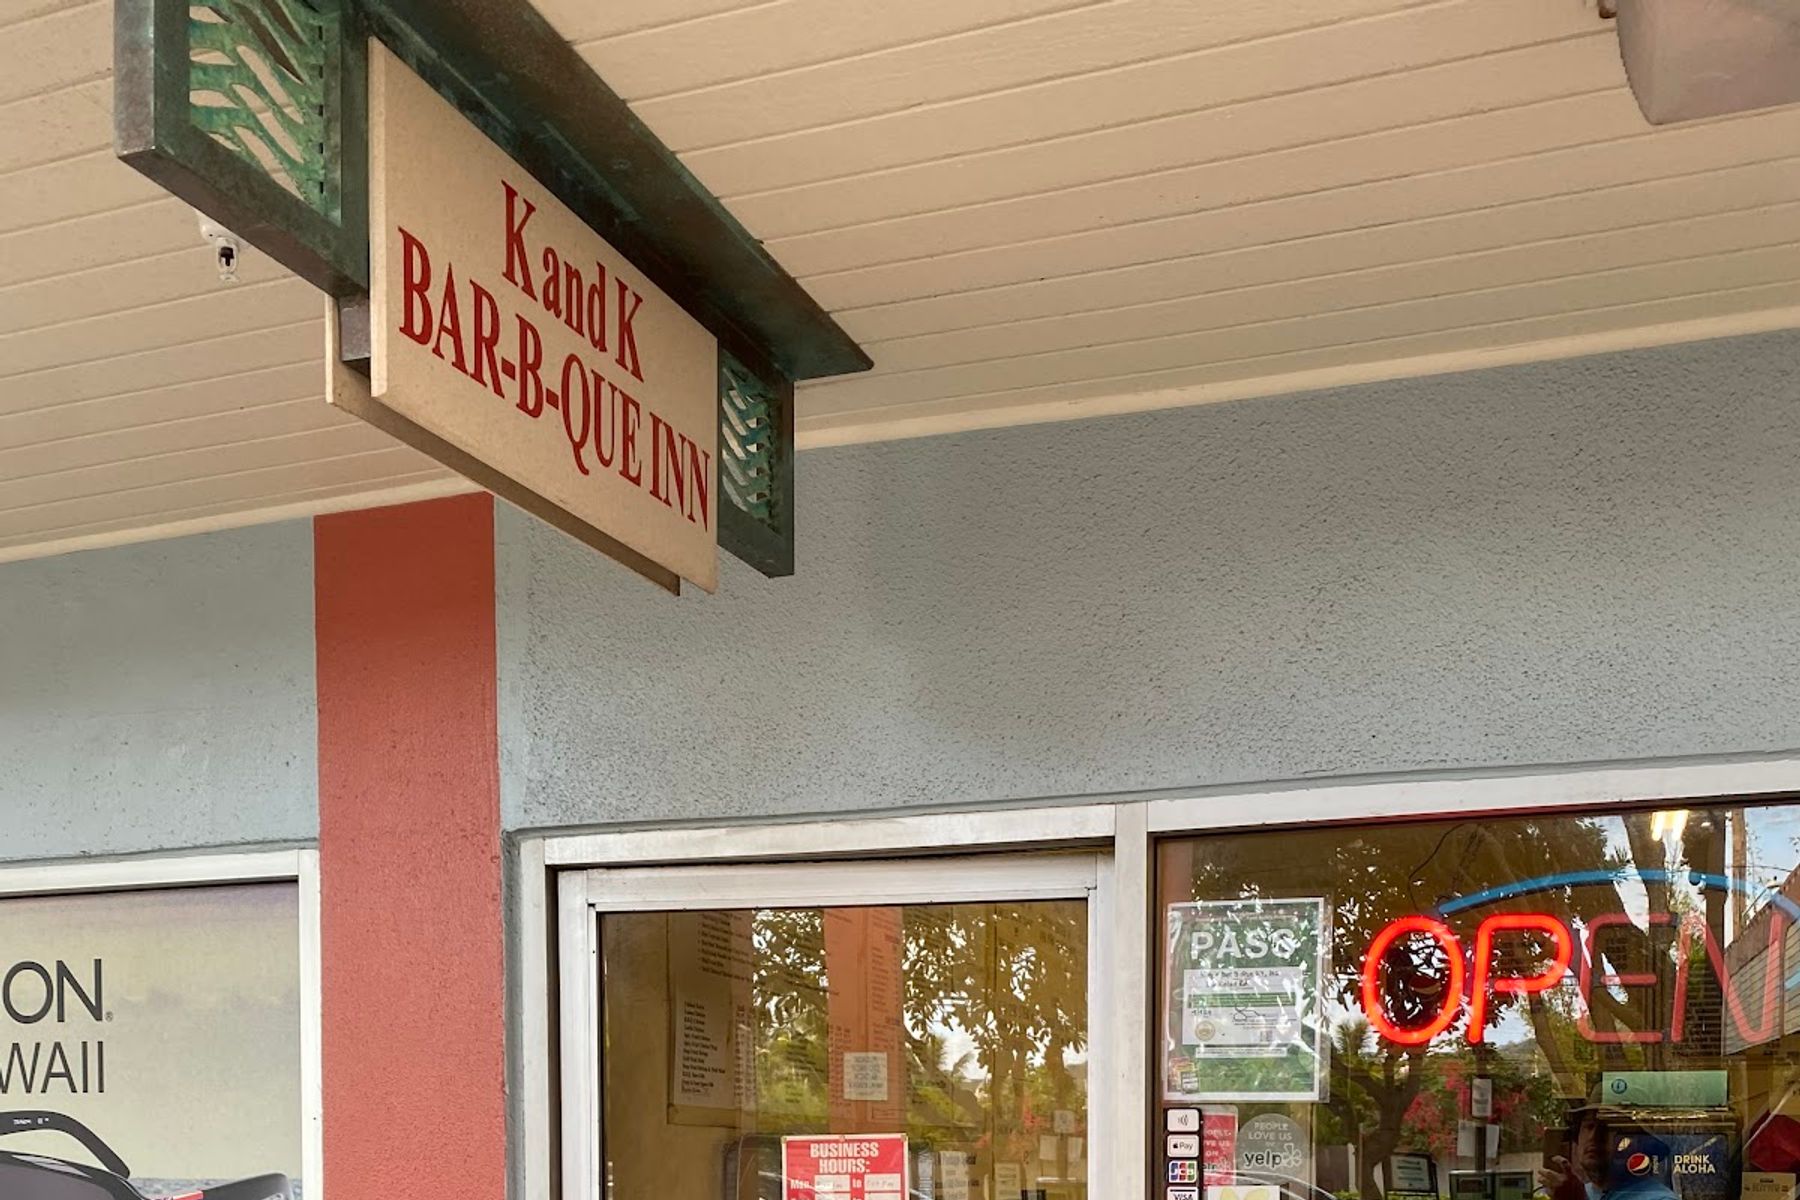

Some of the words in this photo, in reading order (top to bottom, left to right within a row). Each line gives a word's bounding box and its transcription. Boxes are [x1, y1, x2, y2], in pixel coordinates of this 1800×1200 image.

[501, 180, 536, 300] K
[542, 246, 607, 353] and
[615, 277, 645, 383] K
[397, 225, 641, 487] BAR-B-QUE
[649, 411, 711, 532] INN
[1190, 925, 1296, 960] PASS
[1362, 911, 1785, 1045] OPEN
[1254, 1122, 1289, 1131] PEOPLE
[1248, 1131, 1275, 1140] LOVE
[1279, 1132, 1292, 1140] US
[810, 1142, 879, 1158] BUSINESS
[819, 1158, 870, 1174] HOURS:
[1244, 1150, 1282, 1169] yelp
[1674, 1154, 1710, 1164] DRINK
[1673, 1164, 1716, 1174] ALOHA
[853, 1179, 862, 1188] to
[1173, 1193, 1193, 1200] VISA
